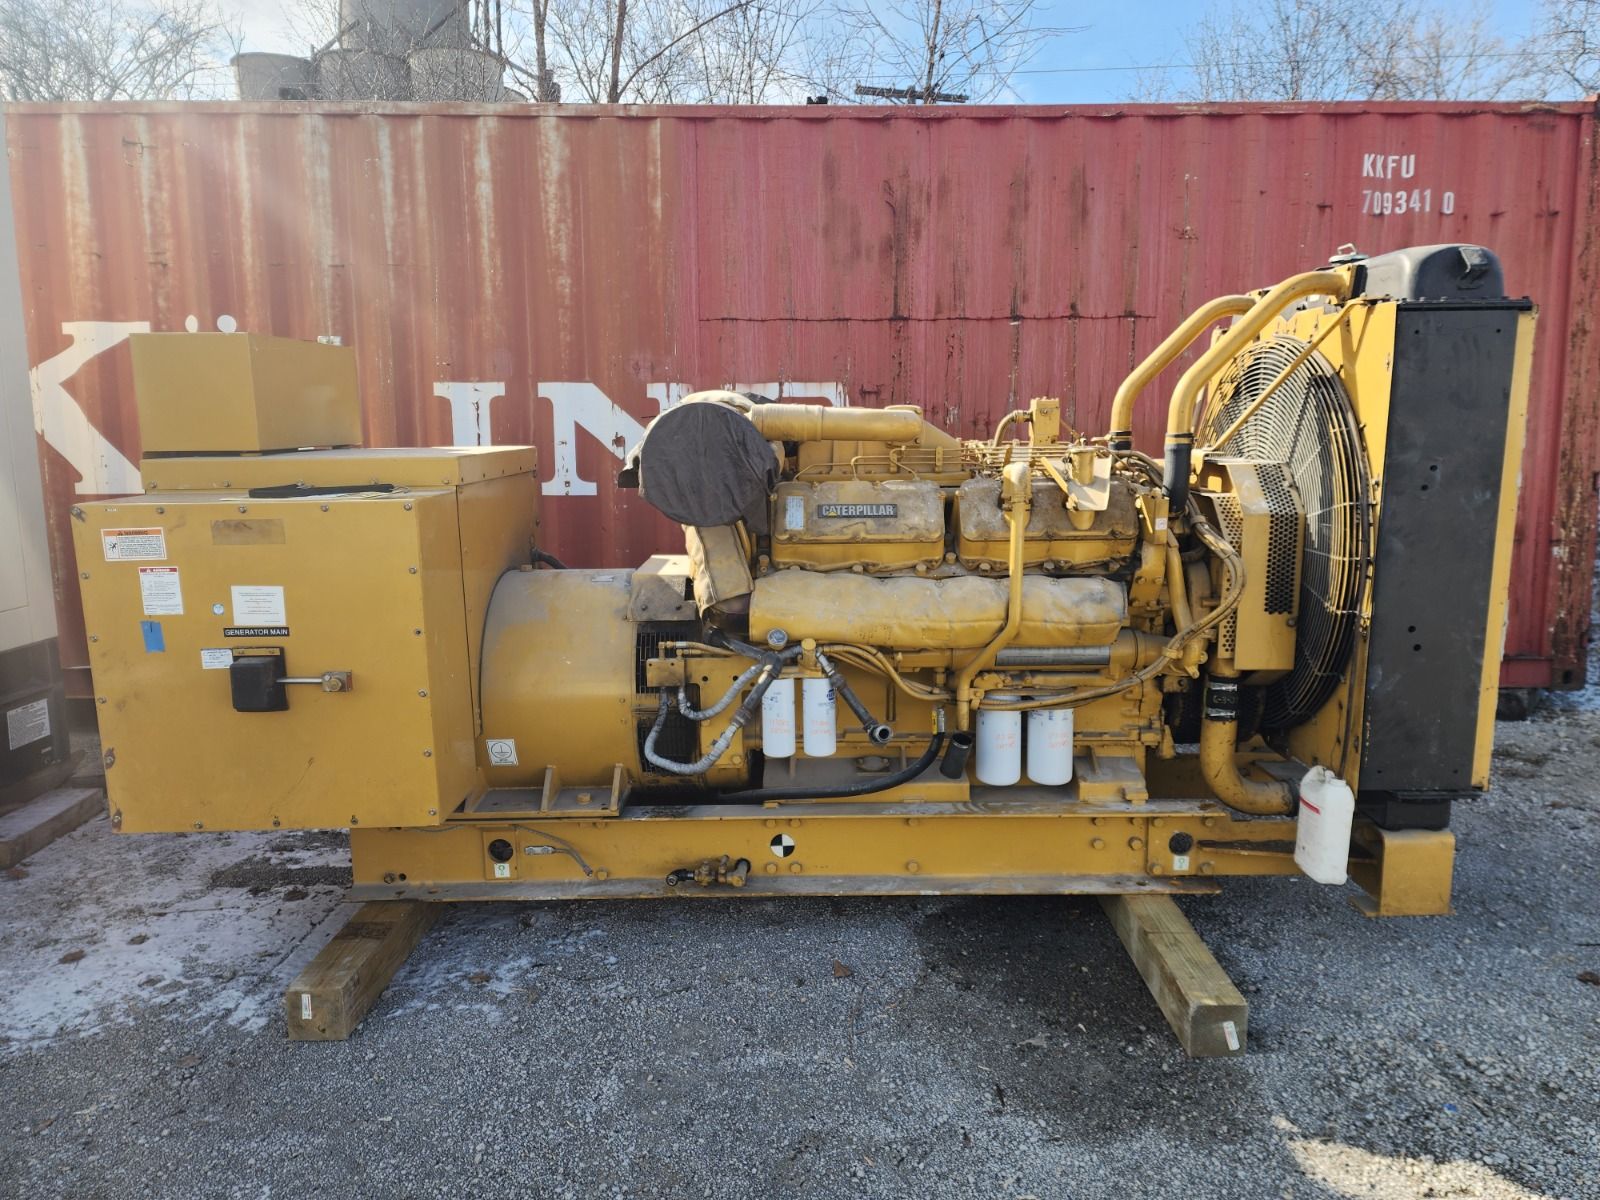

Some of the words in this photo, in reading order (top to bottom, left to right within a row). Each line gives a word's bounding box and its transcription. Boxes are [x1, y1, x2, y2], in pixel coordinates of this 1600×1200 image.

[1362, 153, 1416, 179] KKFU
[1362, 188, 1431, 215] 709341
[822, 505, 894, 516] CATERPILLAR
